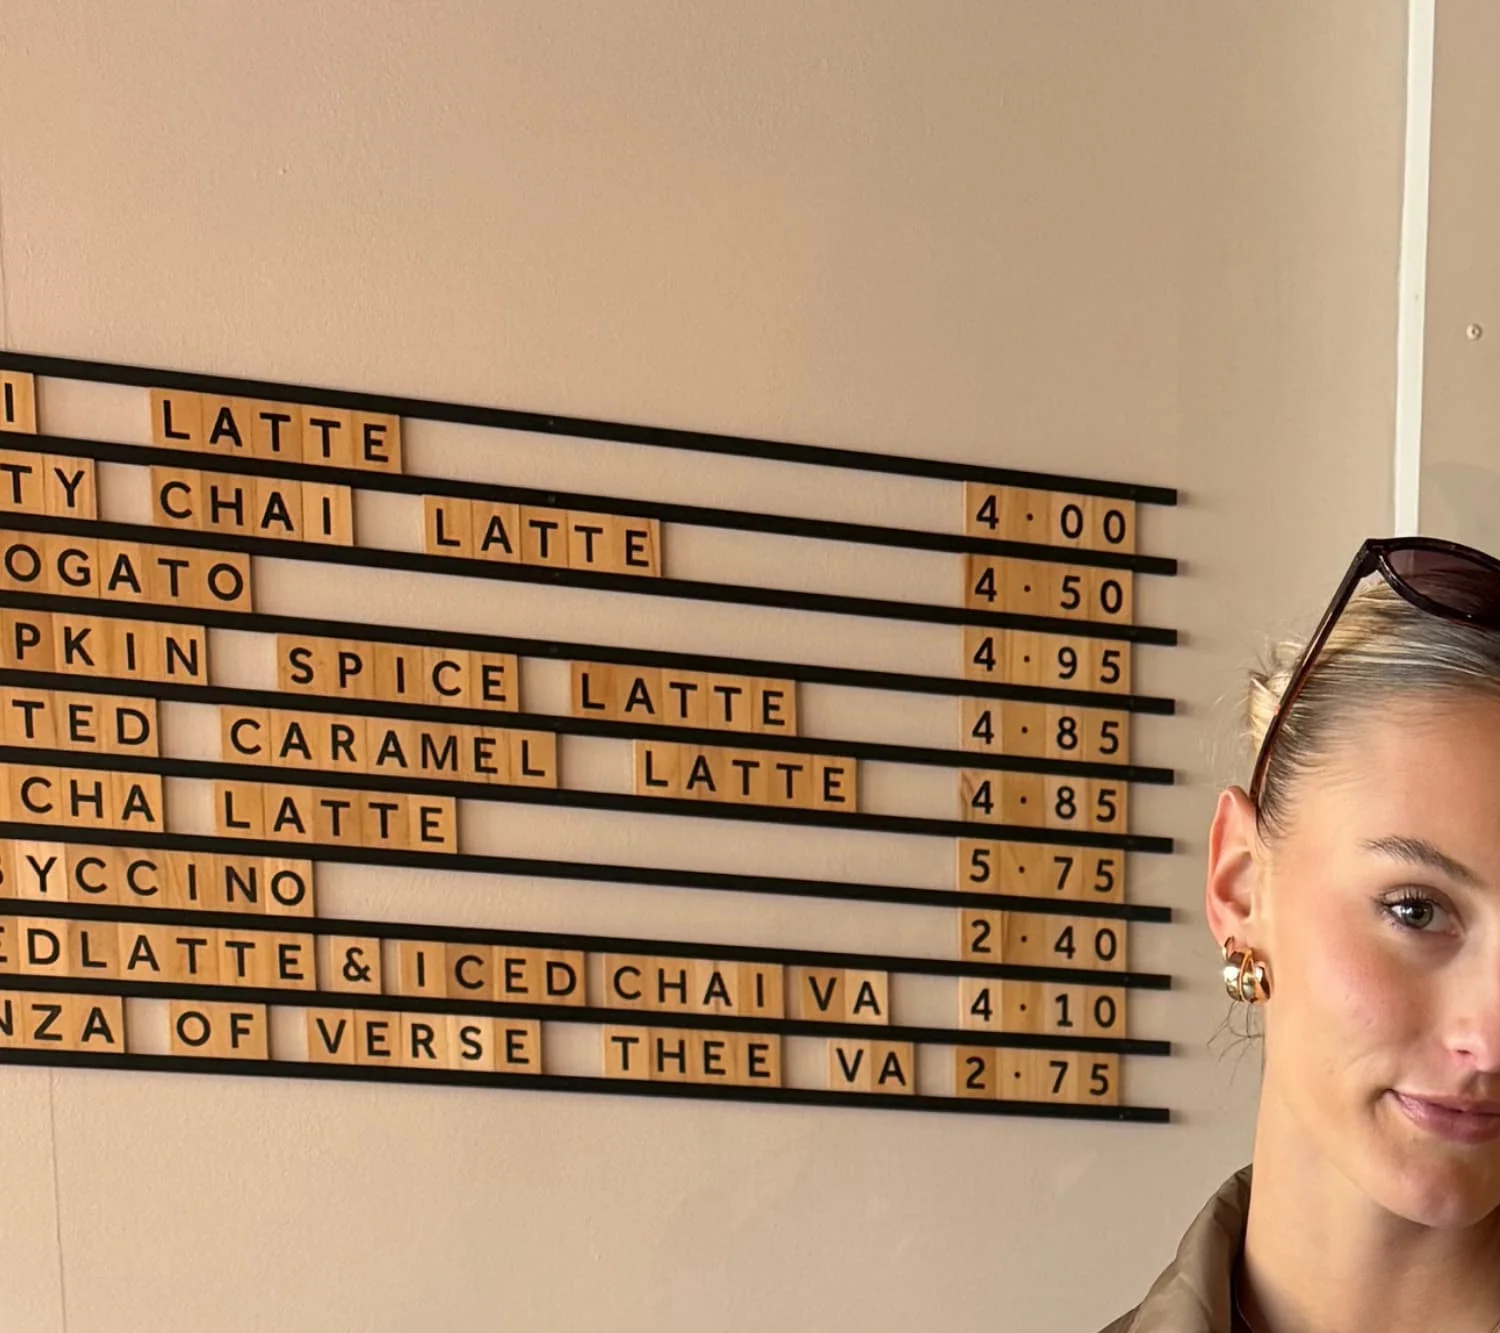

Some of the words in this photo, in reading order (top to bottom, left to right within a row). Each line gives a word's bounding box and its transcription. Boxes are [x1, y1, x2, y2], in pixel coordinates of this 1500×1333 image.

[162, 397, 390, 463] LATTE
[2, 463, 85, 508] TY
[160, 480, 332, 535] CHAI
[435, 508, 649, 568] LATTE
[5, 544, 244, 600] OGATO
[15, 622, 199, 678] PKIN
[289, 648, 506, 702] SPICE
[581, 672, 786, 727] LATTE
[13, 701, 151, 746] TED
[230, 718, 546, 777] CARAMEL
[645, 750, 845, 803] LATTE
[20, 775, 154, 824] CHA
[225, 791, 444, 844] LATTE
[0, 854, 305, 908] YCCINO
[342, 946, 371, 983] &
[416, 950, 577, 998] ICED
[613, 965, 766, 1009] CHAI
[808, 976, 882, 1017] VA
[176, 1011, 254, 1050] OF
[316, 1018, 531, 1065] VERSE
[612, 1036, 770, 1079] THEE
[836, 1048, 907, 1087] VA
